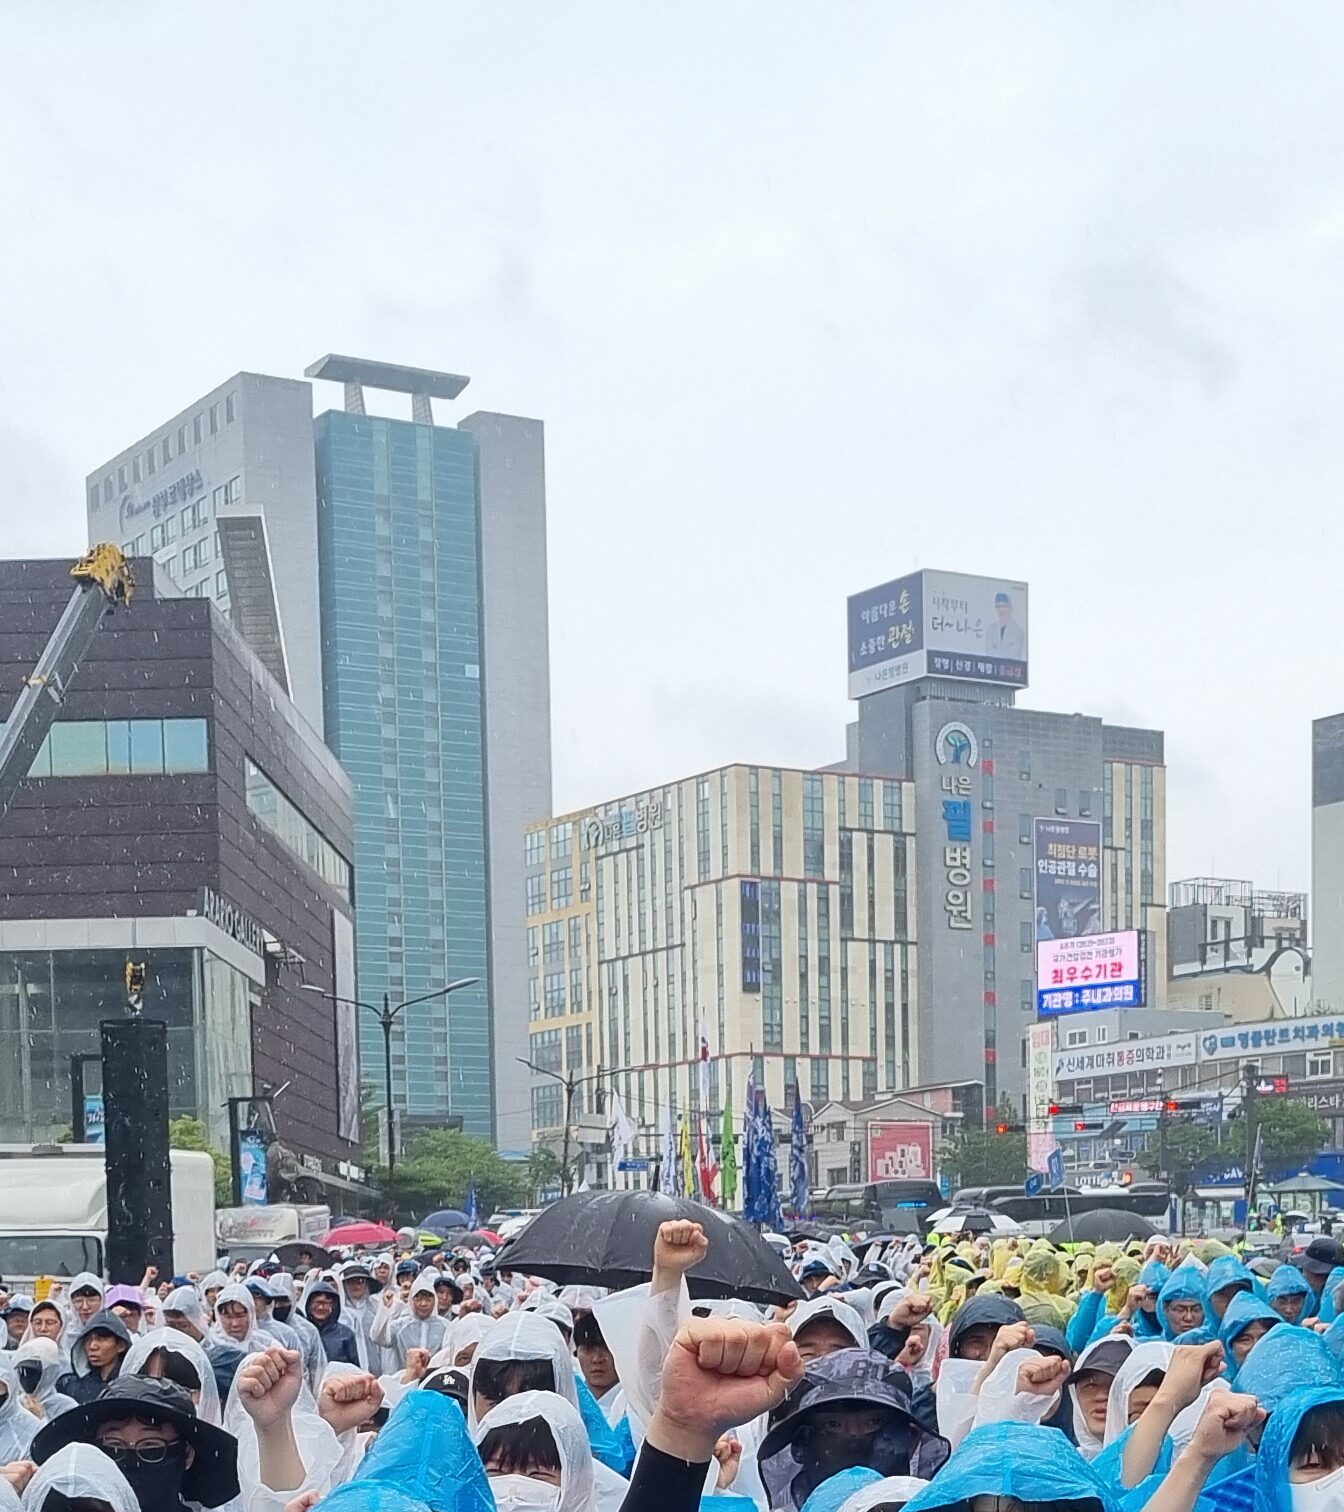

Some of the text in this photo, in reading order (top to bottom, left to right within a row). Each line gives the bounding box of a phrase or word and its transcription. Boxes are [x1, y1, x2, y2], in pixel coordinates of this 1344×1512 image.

[945, 846, 972, 930] 병원
[1052, 961, 1123, 985] 최우수기관
[1067, 1045, 1165, 1073] 신세계마취통증의학과
